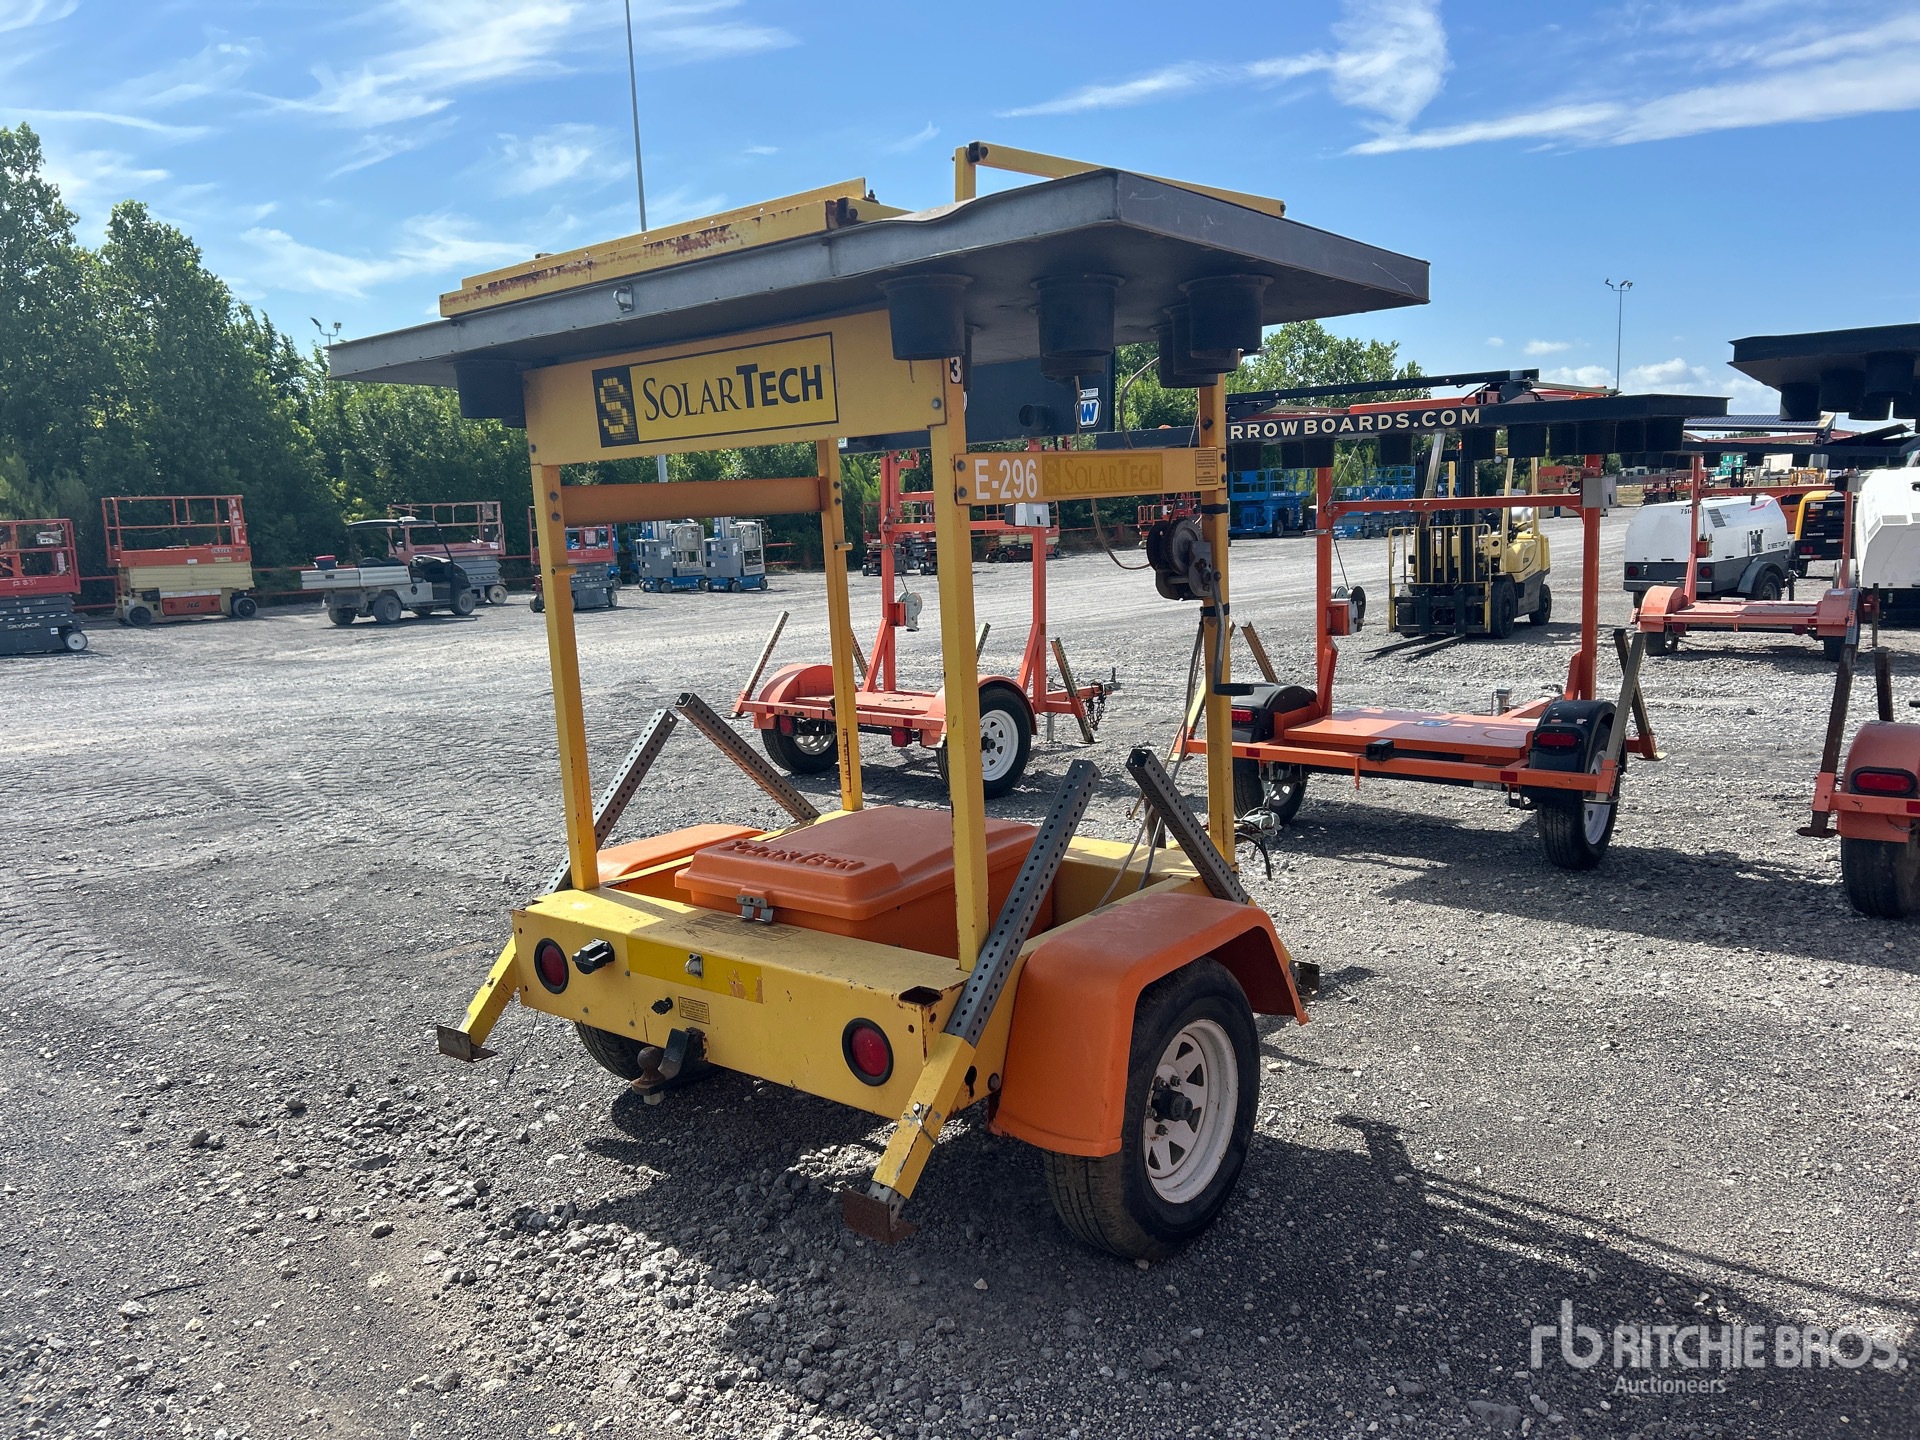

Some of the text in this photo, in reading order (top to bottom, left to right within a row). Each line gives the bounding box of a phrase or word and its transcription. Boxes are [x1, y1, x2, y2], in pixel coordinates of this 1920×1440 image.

[950, 356, 962, 383] 3
[1081, 402, 1097, 422] W
[1229, 408, 1481, 440] RROWBOARDS.COM
[974, 458, 1038, 500] E-296
[7, 622, 41, 630] SKYJACK
